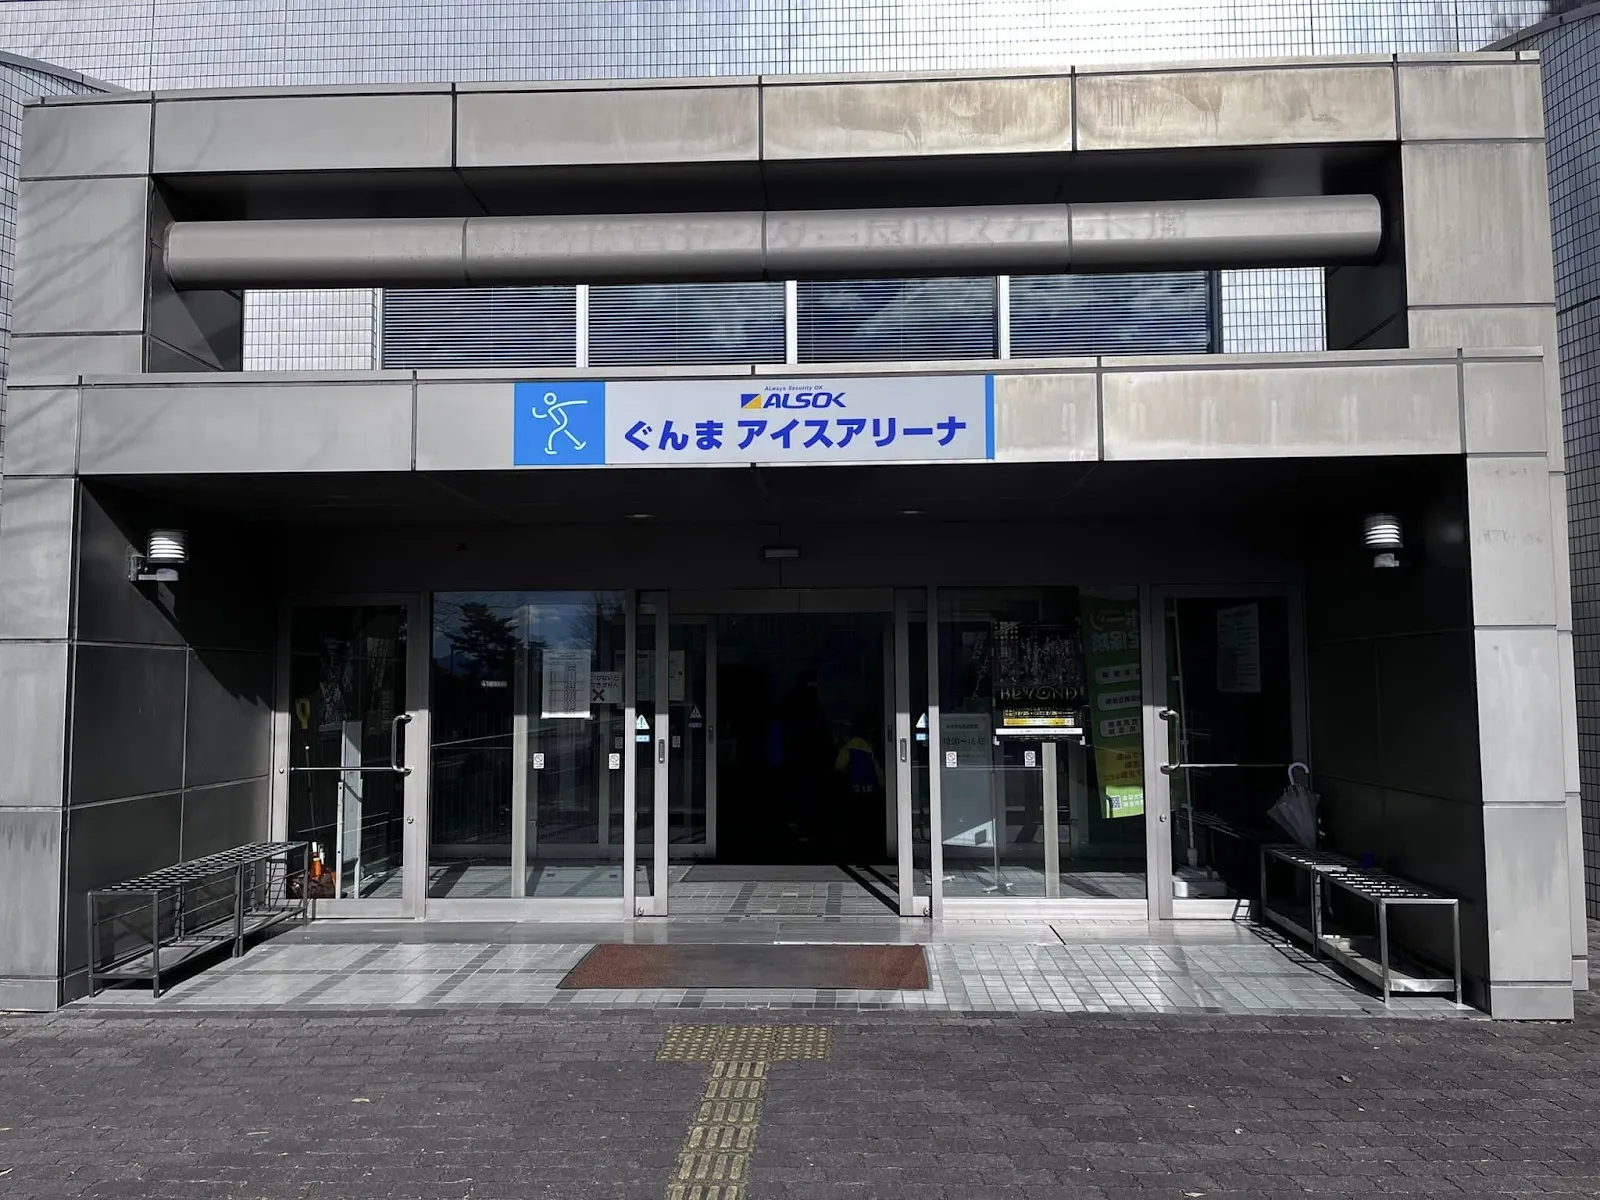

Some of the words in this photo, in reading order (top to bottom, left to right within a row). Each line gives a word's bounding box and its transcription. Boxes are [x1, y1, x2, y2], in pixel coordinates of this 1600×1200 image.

[763, 392, 847, 409] ALSOK
[624, 420, 724, 451] ぐんま
[737, 416, 966, 450] アイスアリーナ
[1001, 686, 1077, 699] BEYOND
